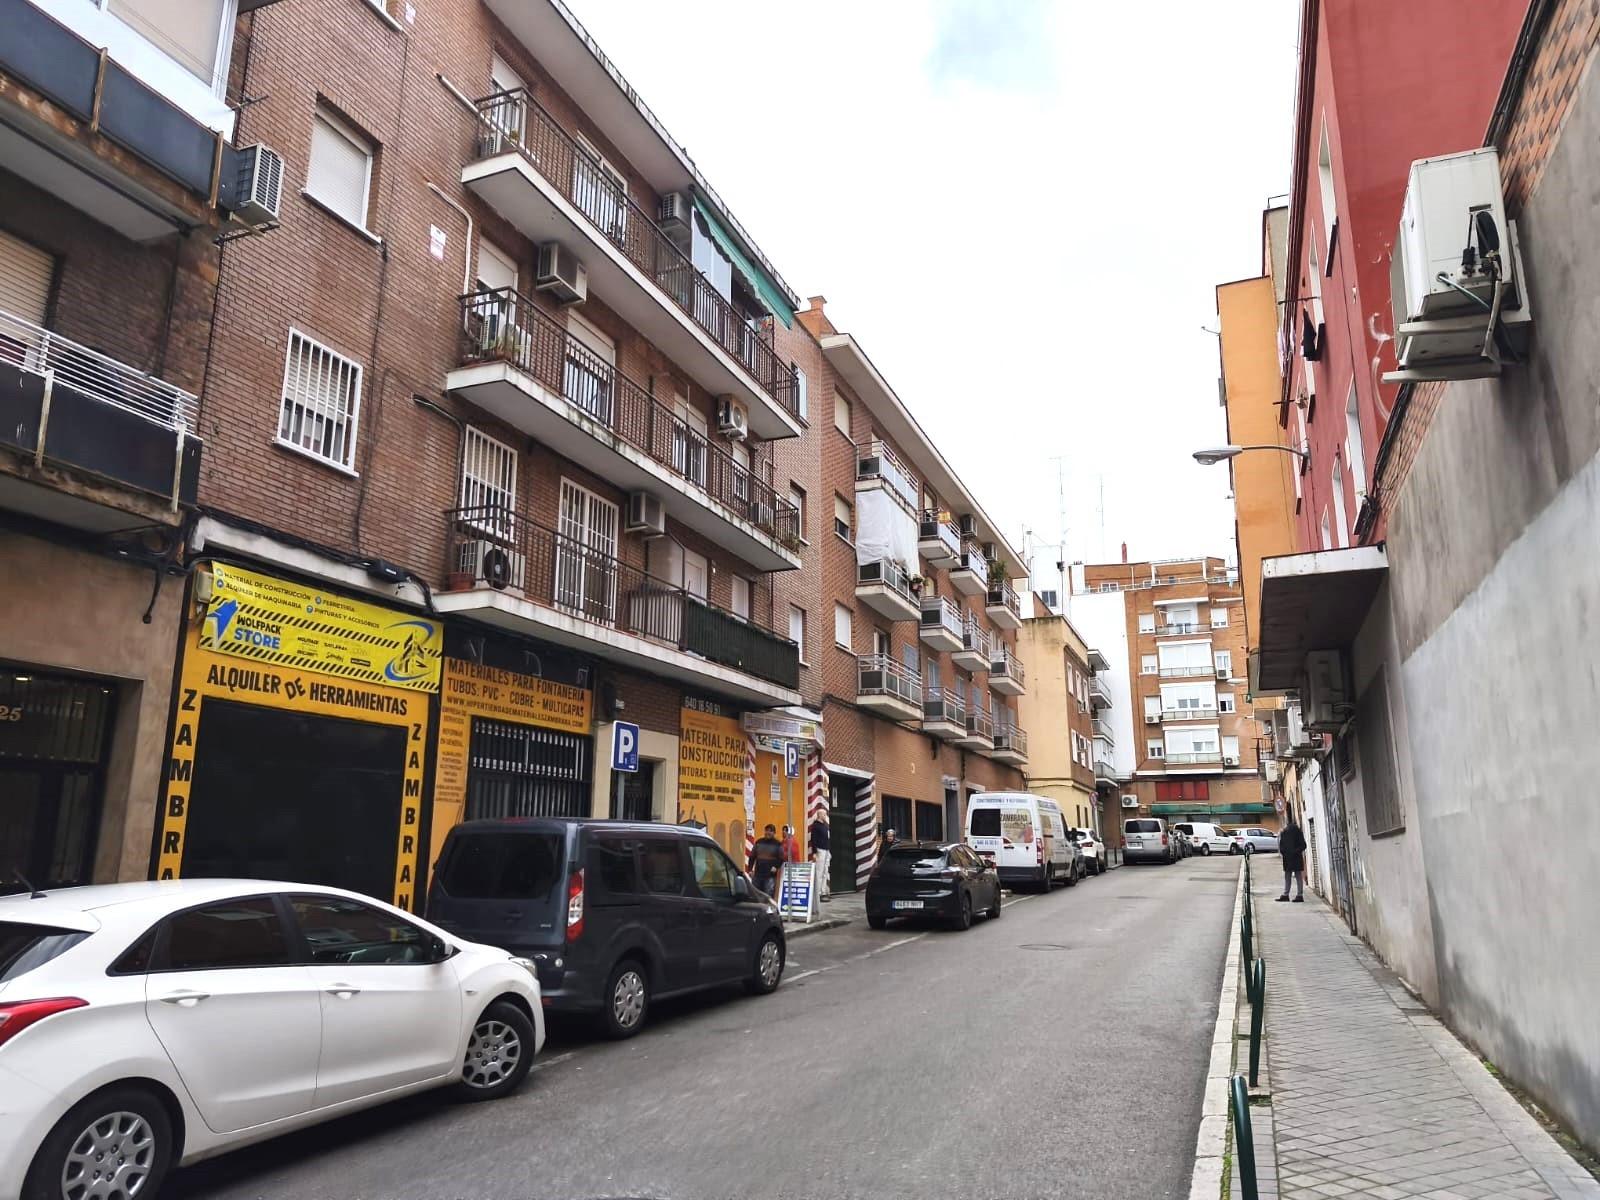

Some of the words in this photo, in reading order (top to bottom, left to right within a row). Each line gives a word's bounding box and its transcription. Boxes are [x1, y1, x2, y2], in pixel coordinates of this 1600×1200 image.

[263, 595, 302, 609] MAQUINARIA
[236, 614, 281, 635] WOLFPACK
[234, 628, 281, 649] STORE
[448, 658, 509, 686] MATERIALES
[512, 673, 534, 691] PARA
[207, 664, 281, 694] ALQUILER
[284, 677, 306, 700] DE
[309, 682, 408, 716] HERRAMIENTAS
[482, 685, 500, 701] PVC
[509, 690, 534, 708] COBRE
[542, 698, 585, 718] MULTICAPAS
[0, 705, 23, 721] 25
[618, 728, 634, 764] P
[725, 735, 746, 754] PARA
[788, 747, 797, 774] P
[708, 769, 714, 779] Y
[714, 770, 744, 783] BARNICES
